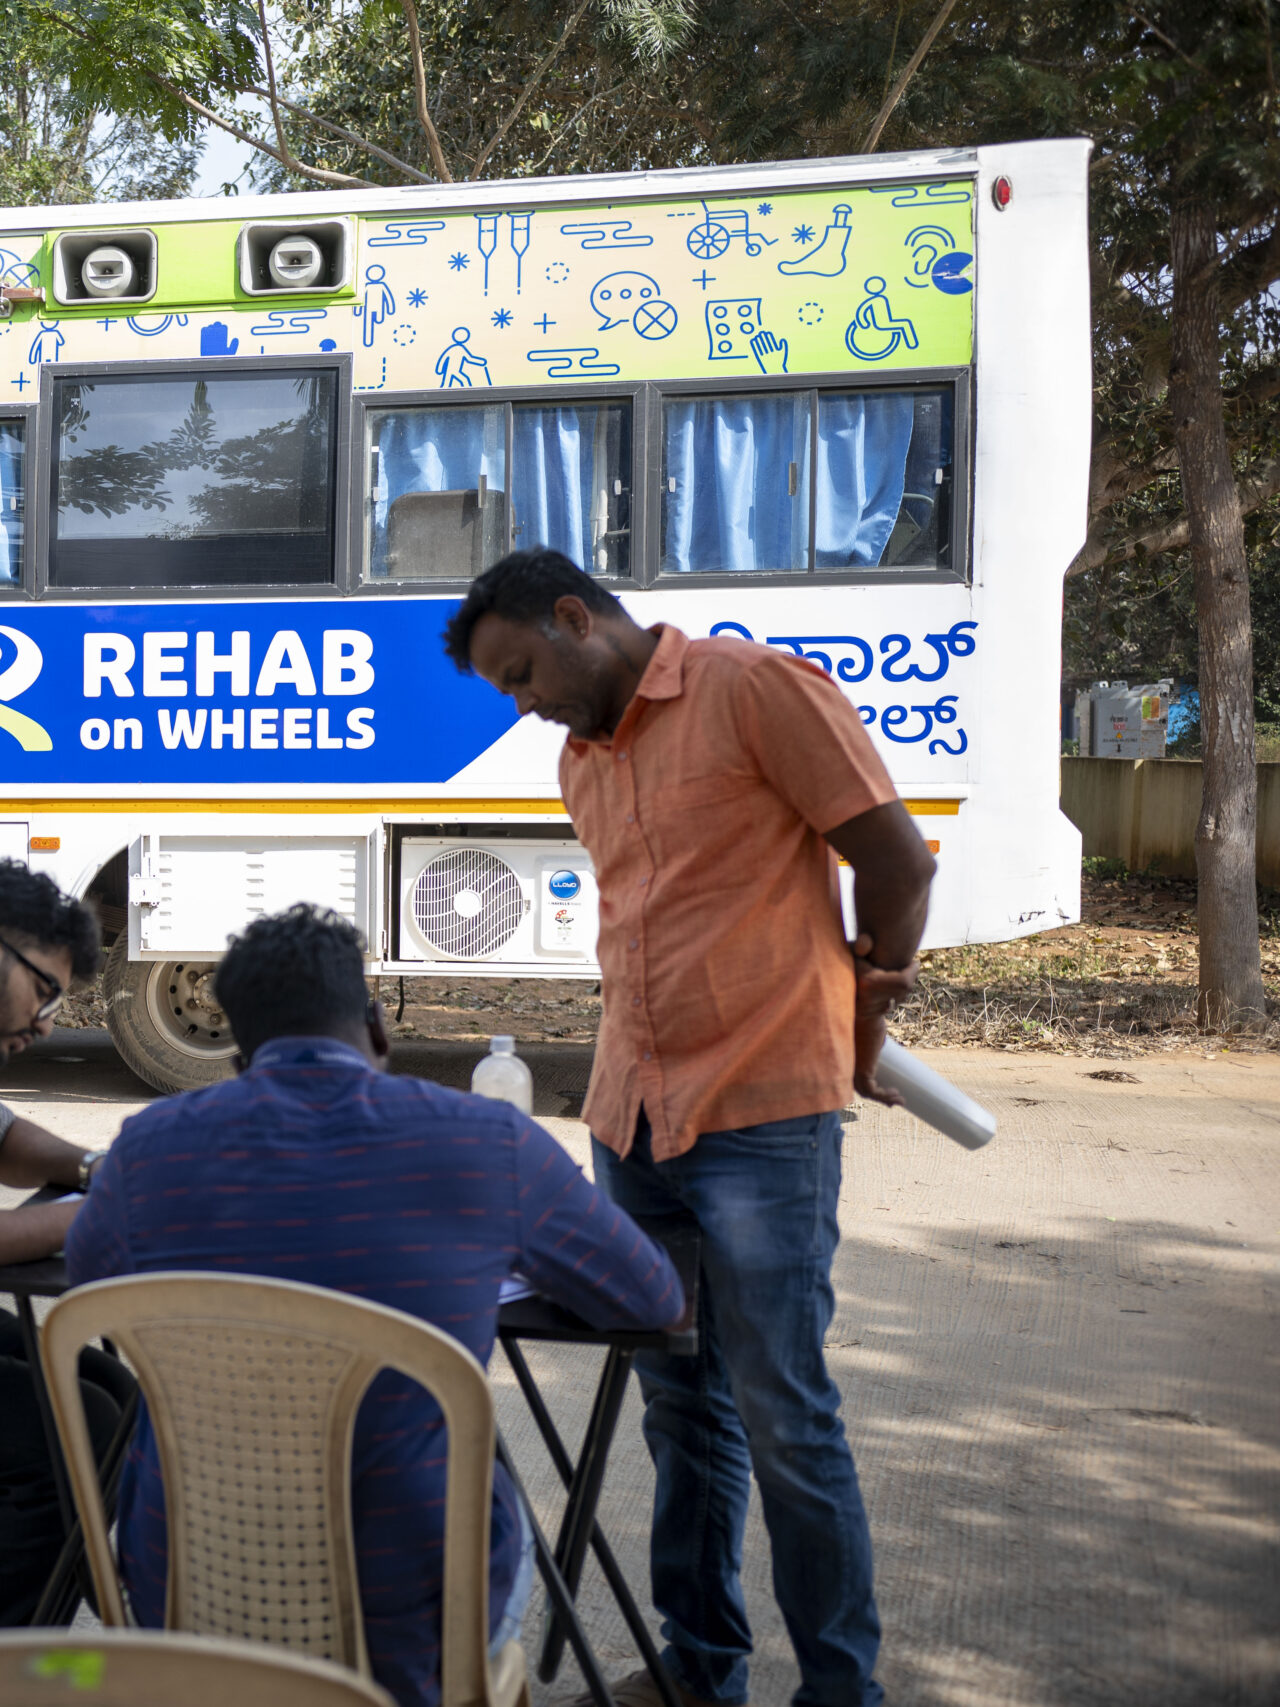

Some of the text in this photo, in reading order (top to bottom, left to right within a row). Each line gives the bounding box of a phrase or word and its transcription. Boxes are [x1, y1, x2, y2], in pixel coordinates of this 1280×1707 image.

[82, 629, 376, 698] REHAB
[79, 707, 376, 750] on WHEELS
